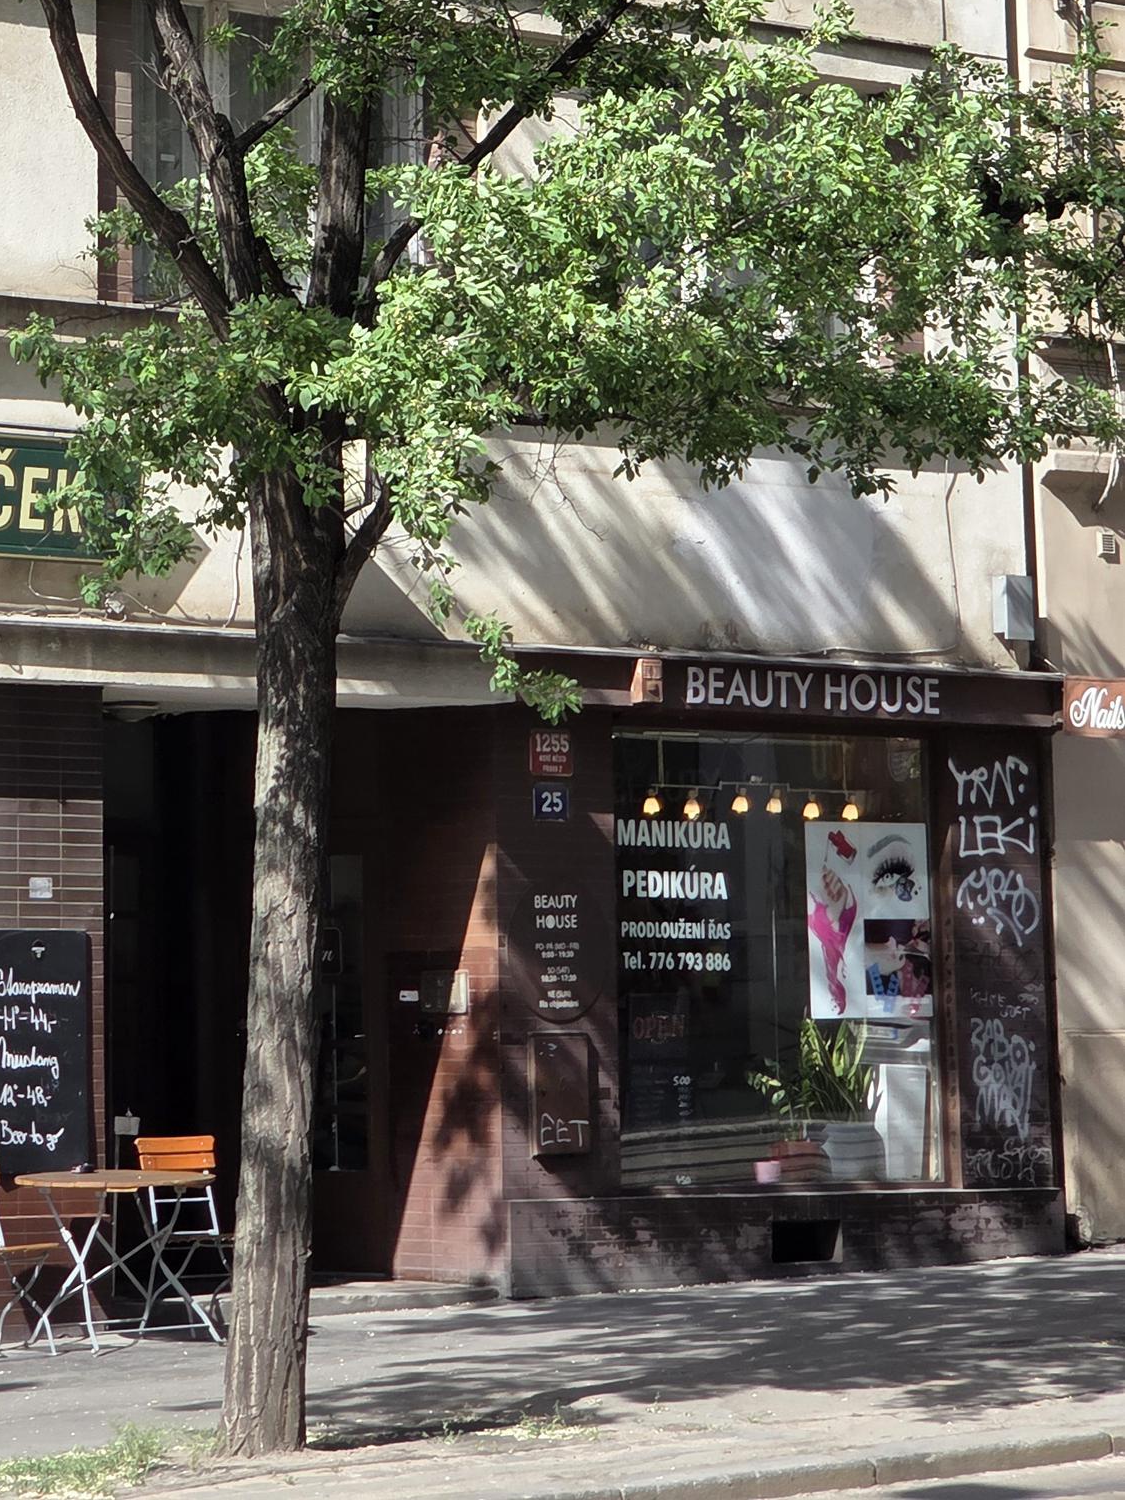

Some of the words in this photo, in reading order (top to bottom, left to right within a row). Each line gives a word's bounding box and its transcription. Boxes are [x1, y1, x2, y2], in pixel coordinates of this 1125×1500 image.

[686, 666, 814, 709] BEAUTY
[824, 673, 940, 716] HOUSE
[535, 733, 570, 753] 1255
[541, 791, 563, 812] 25
[623, 864, 728, 900] PEDIKÚRA
[534, 895, 578, 909] BEAUTY
[536, 914, 578, 929] HOUSE
[621, 918, 705, 939] PRODLOUŽENÍ
[708, 919, 731, 940] ŘAS
[623, 951, 646, 970] Tel.
[649, 952, 675, 970] 776
[678, 952, 703, 971] 793
[705, 953, 731, 972] 886
